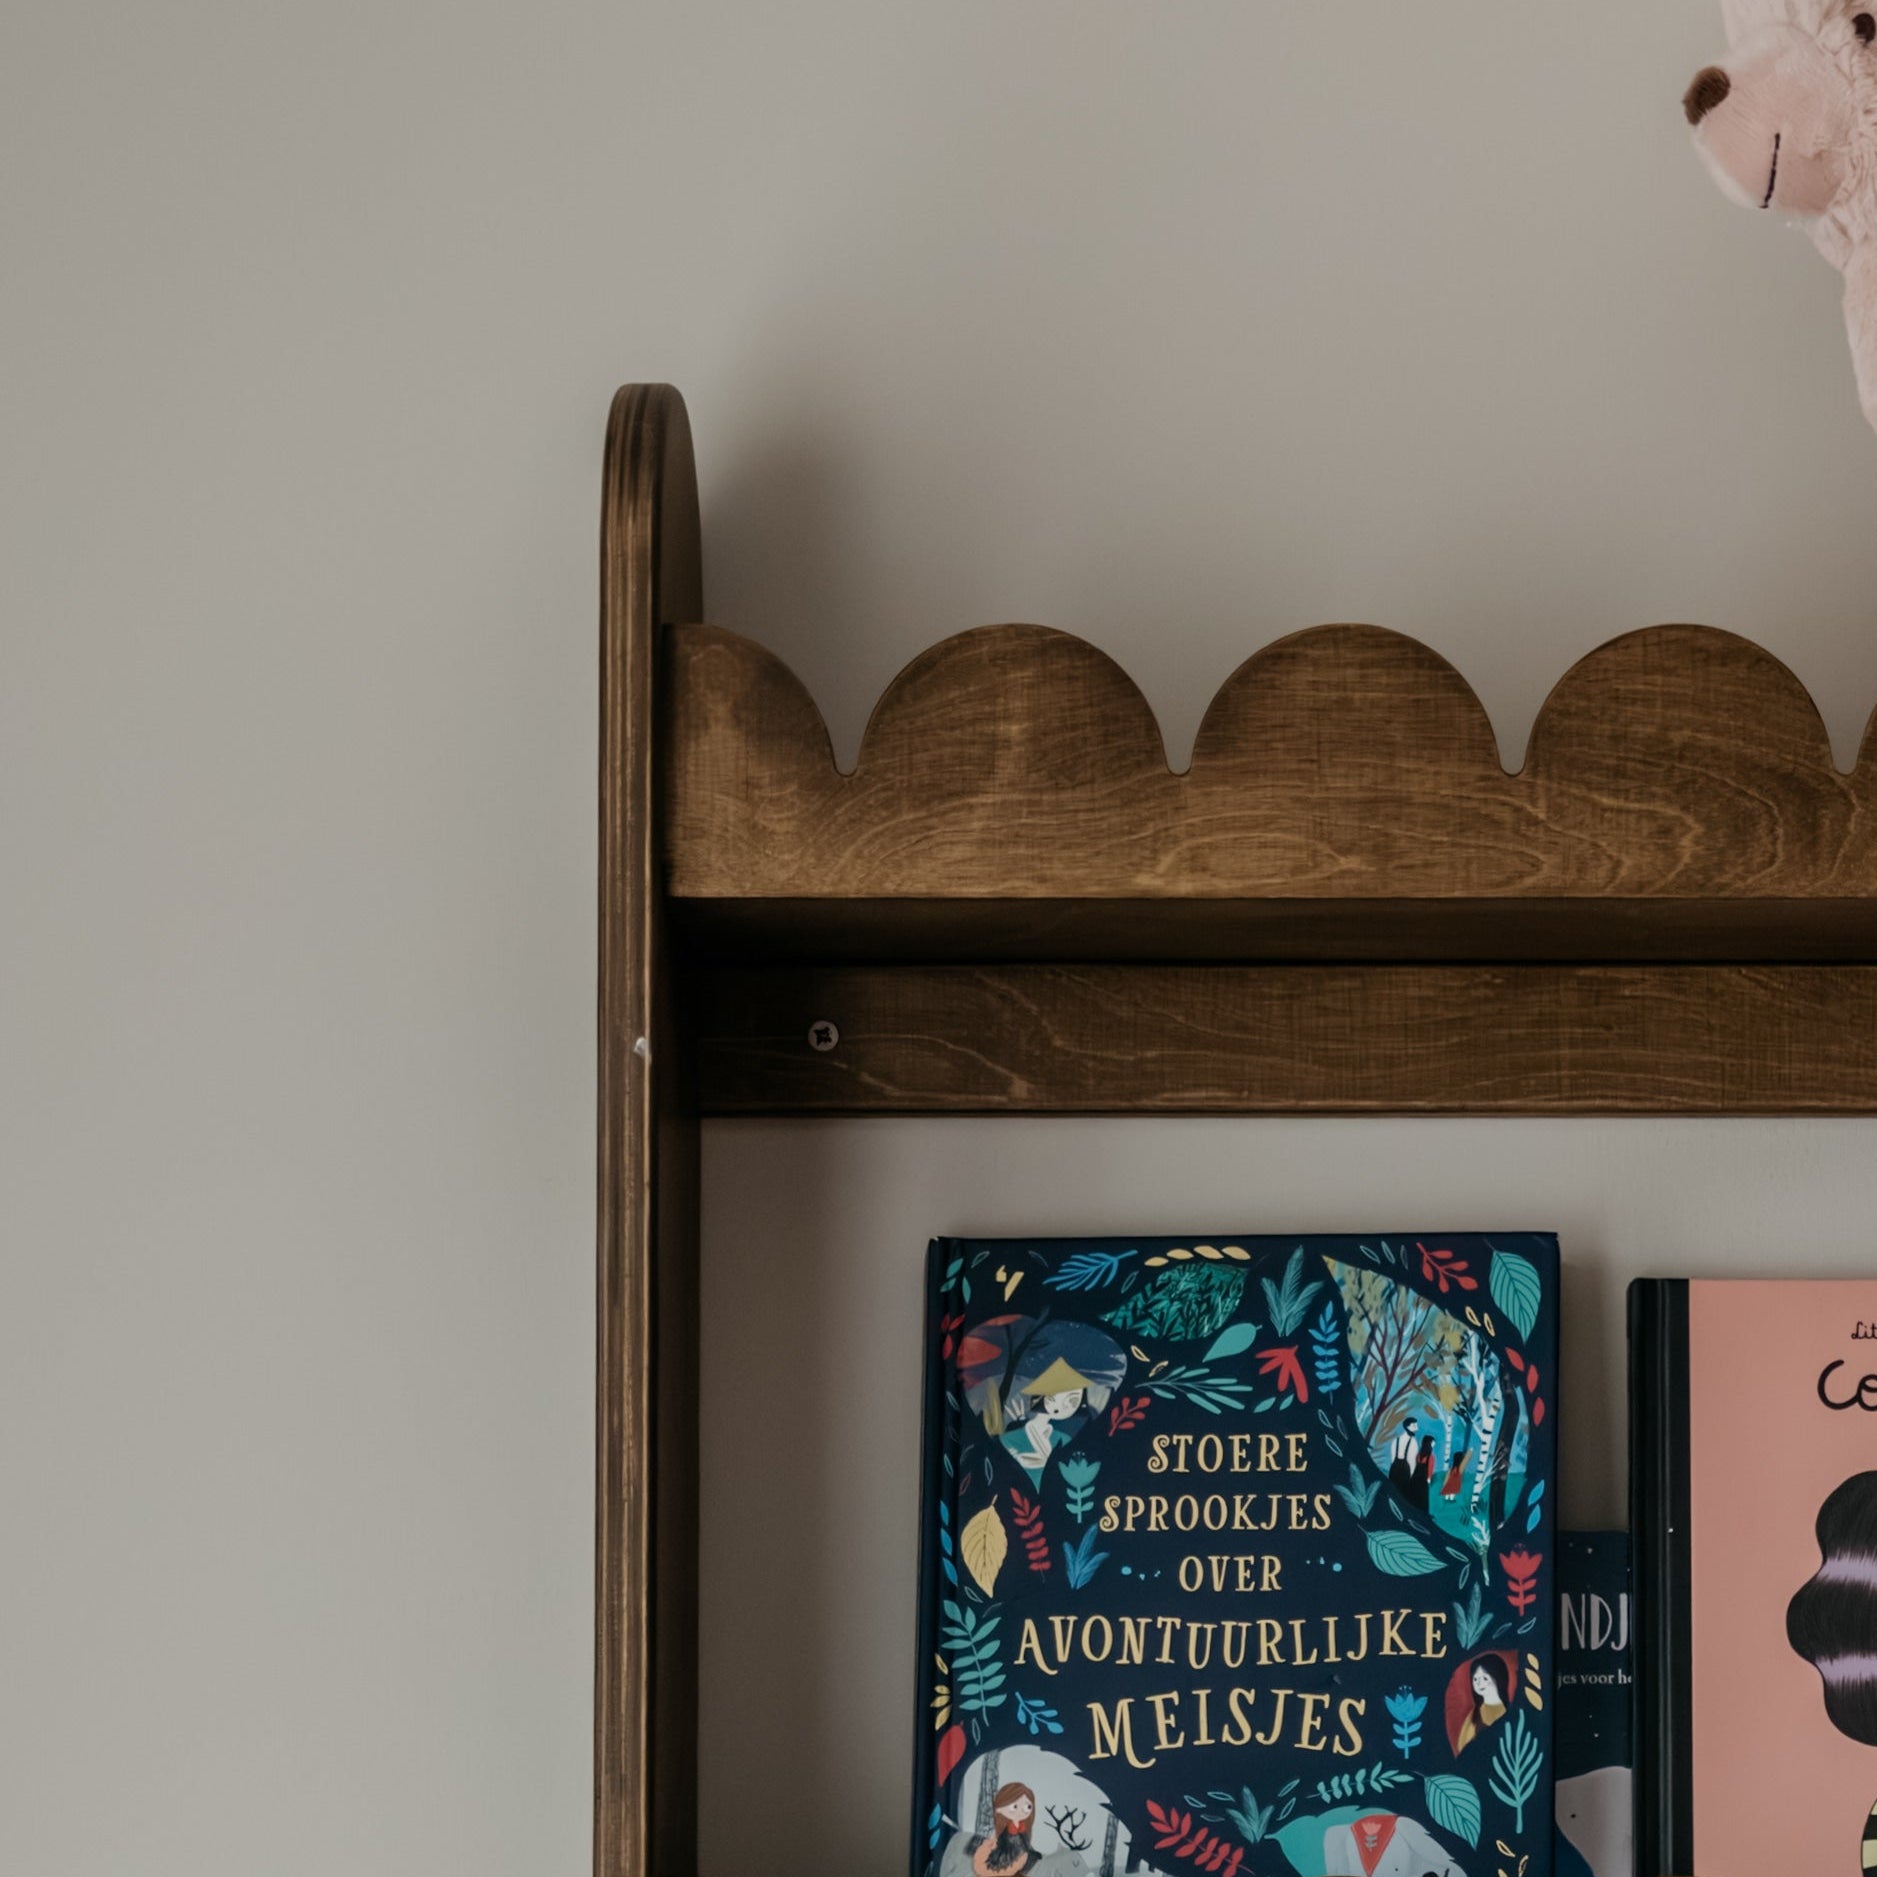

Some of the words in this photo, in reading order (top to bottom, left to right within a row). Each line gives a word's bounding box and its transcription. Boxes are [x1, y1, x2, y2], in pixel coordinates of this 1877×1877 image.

[1147, 1433, 1308, 1474] STOERE
[1100, 1494, 1332, 1533] SPROOKJES
[1178, 1555, 1283, 1593] OVER
[1013, 1608, 1448, 1676] AVONTUURLIJKE
[1580, 1674, 1615, 1684] voor
[1086, 1687, 1367, 1769] MEISJES
